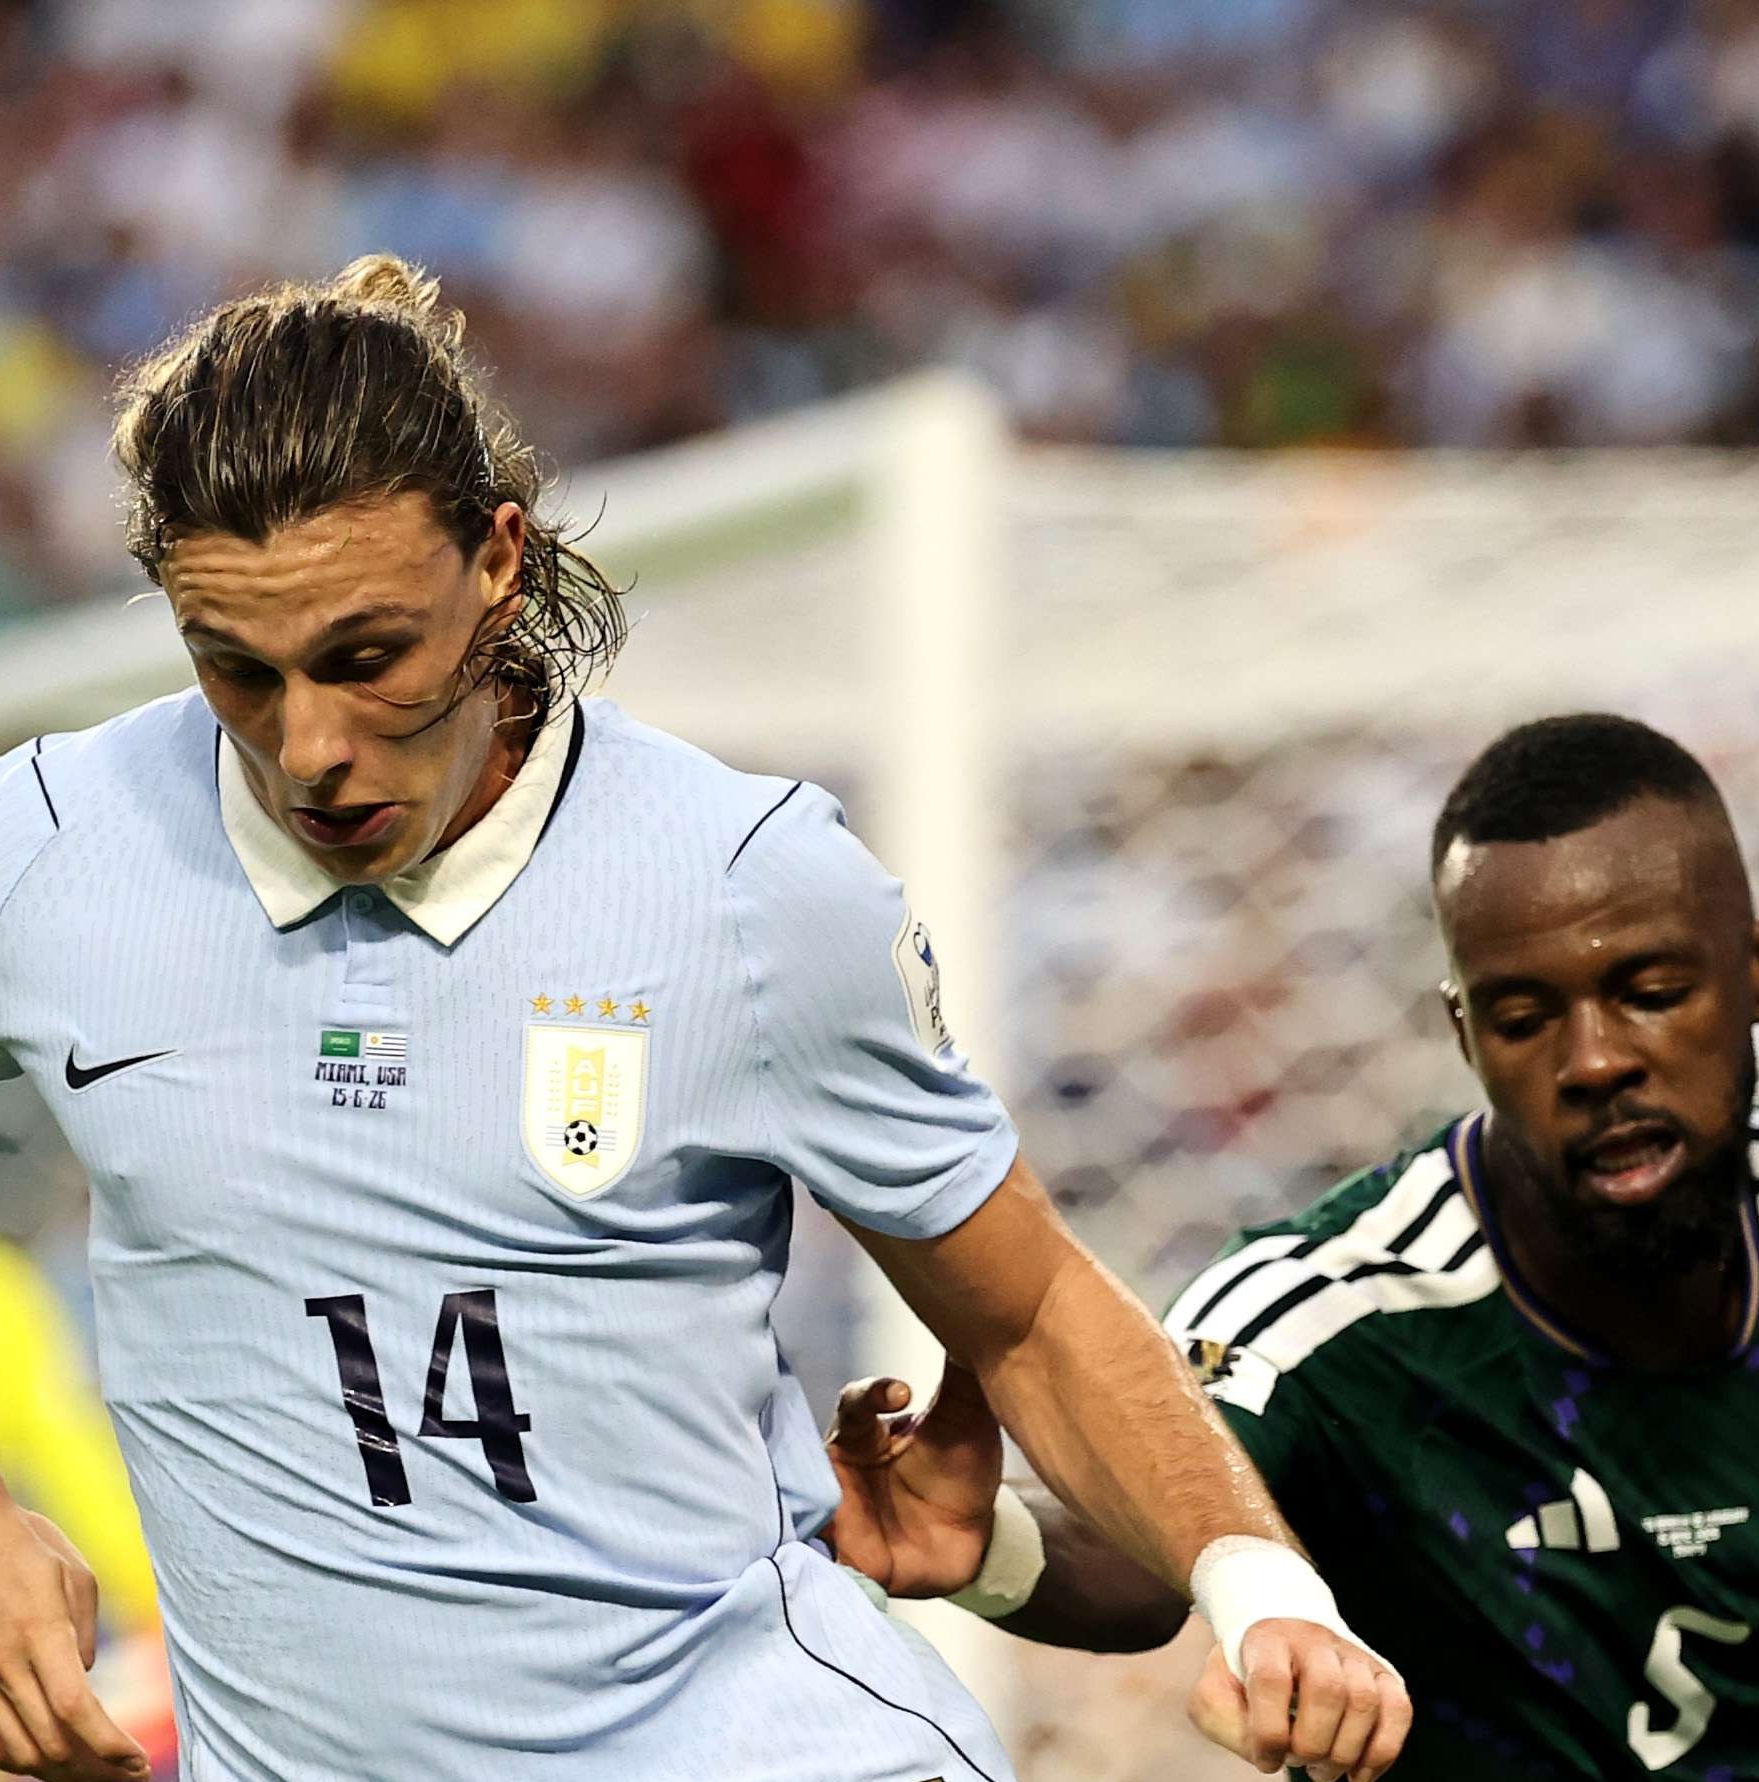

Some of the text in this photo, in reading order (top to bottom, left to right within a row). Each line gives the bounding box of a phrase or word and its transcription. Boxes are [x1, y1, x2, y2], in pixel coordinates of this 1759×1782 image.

[314, 1061, 407, 1087] MIAMI, USA
[305, 1288, 537, 1508] 14
[1626, 1606, 1751, 1772] 5
